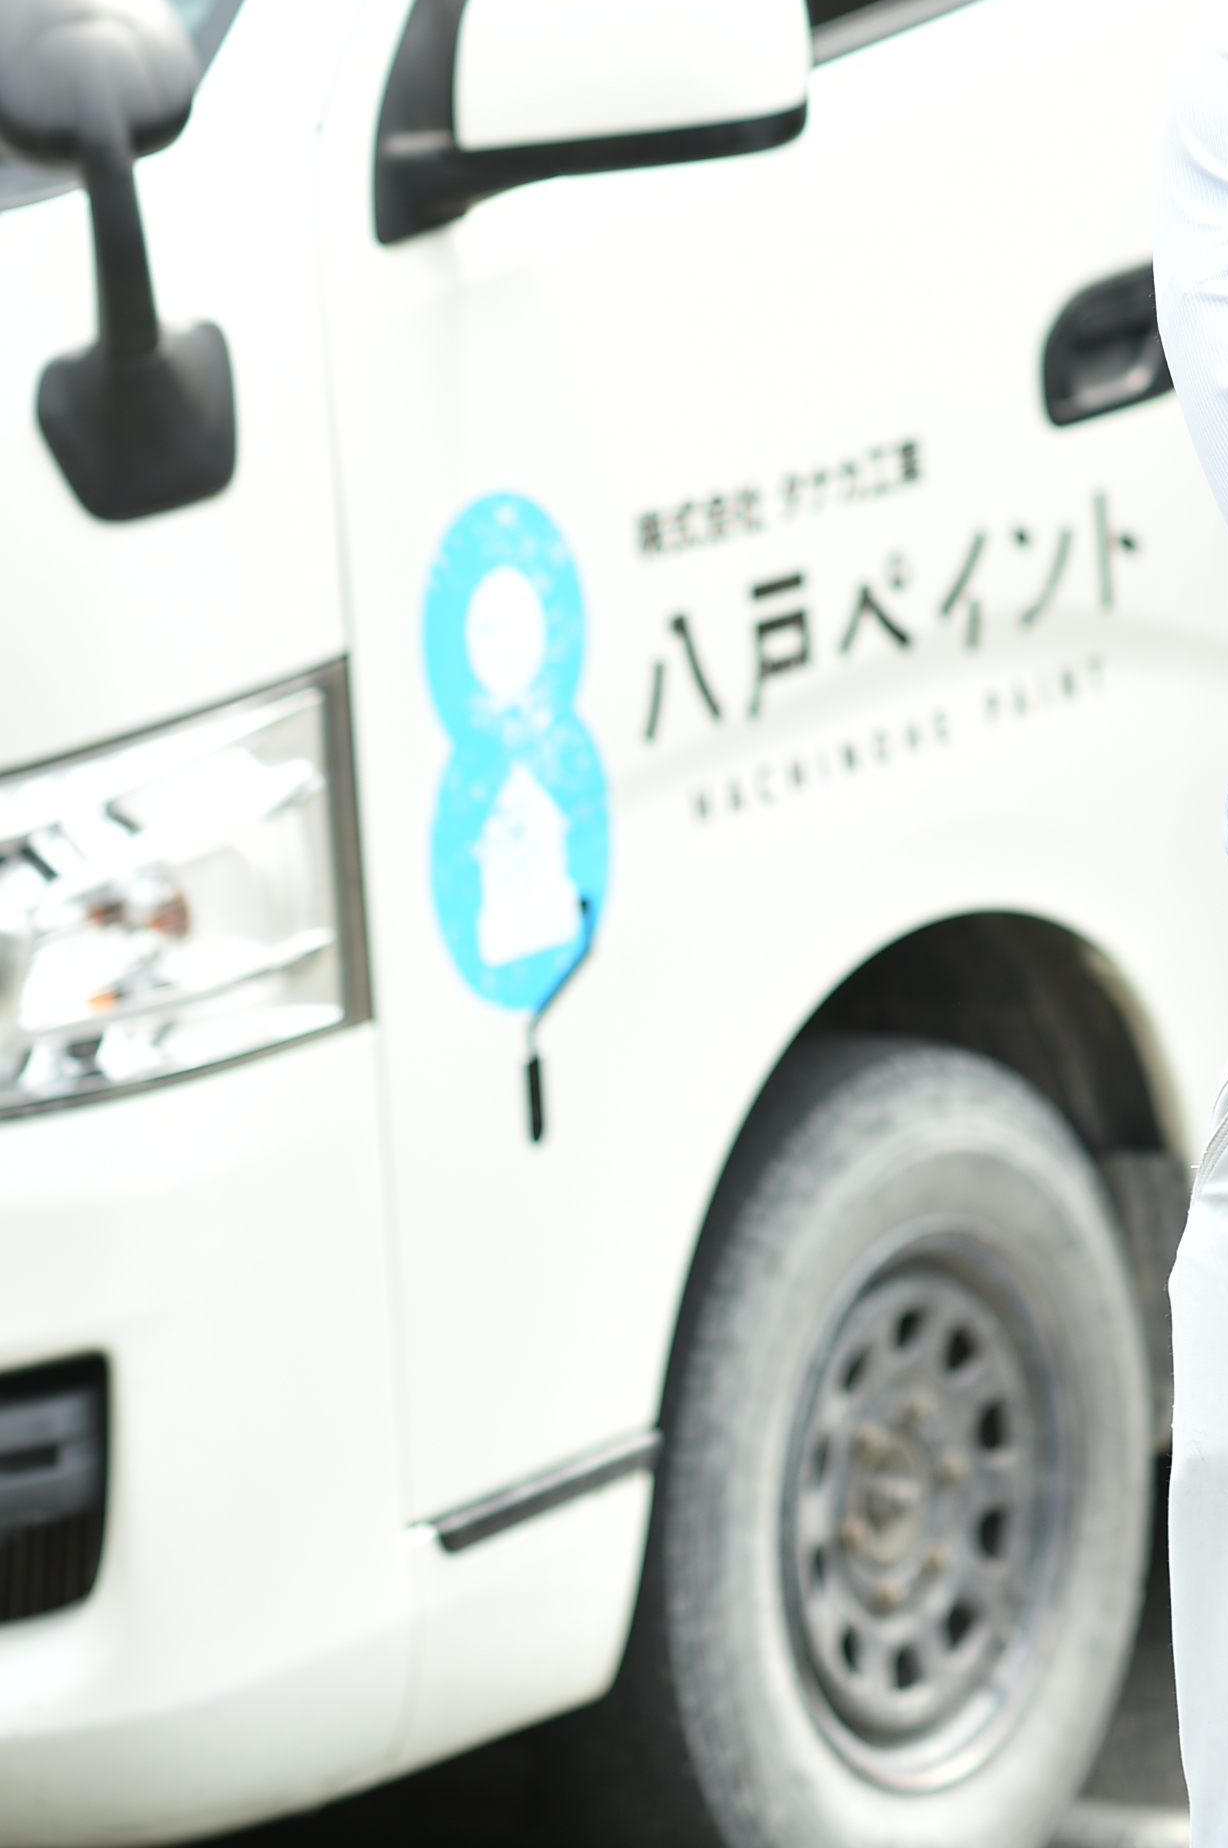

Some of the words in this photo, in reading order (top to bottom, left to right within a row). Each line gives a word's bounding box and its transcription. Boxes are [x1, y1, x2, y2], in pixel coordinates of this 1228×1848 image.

[636, 487, 764, 560] 株式会社
[640, 486, 1142, 746] 八戸ペイント
